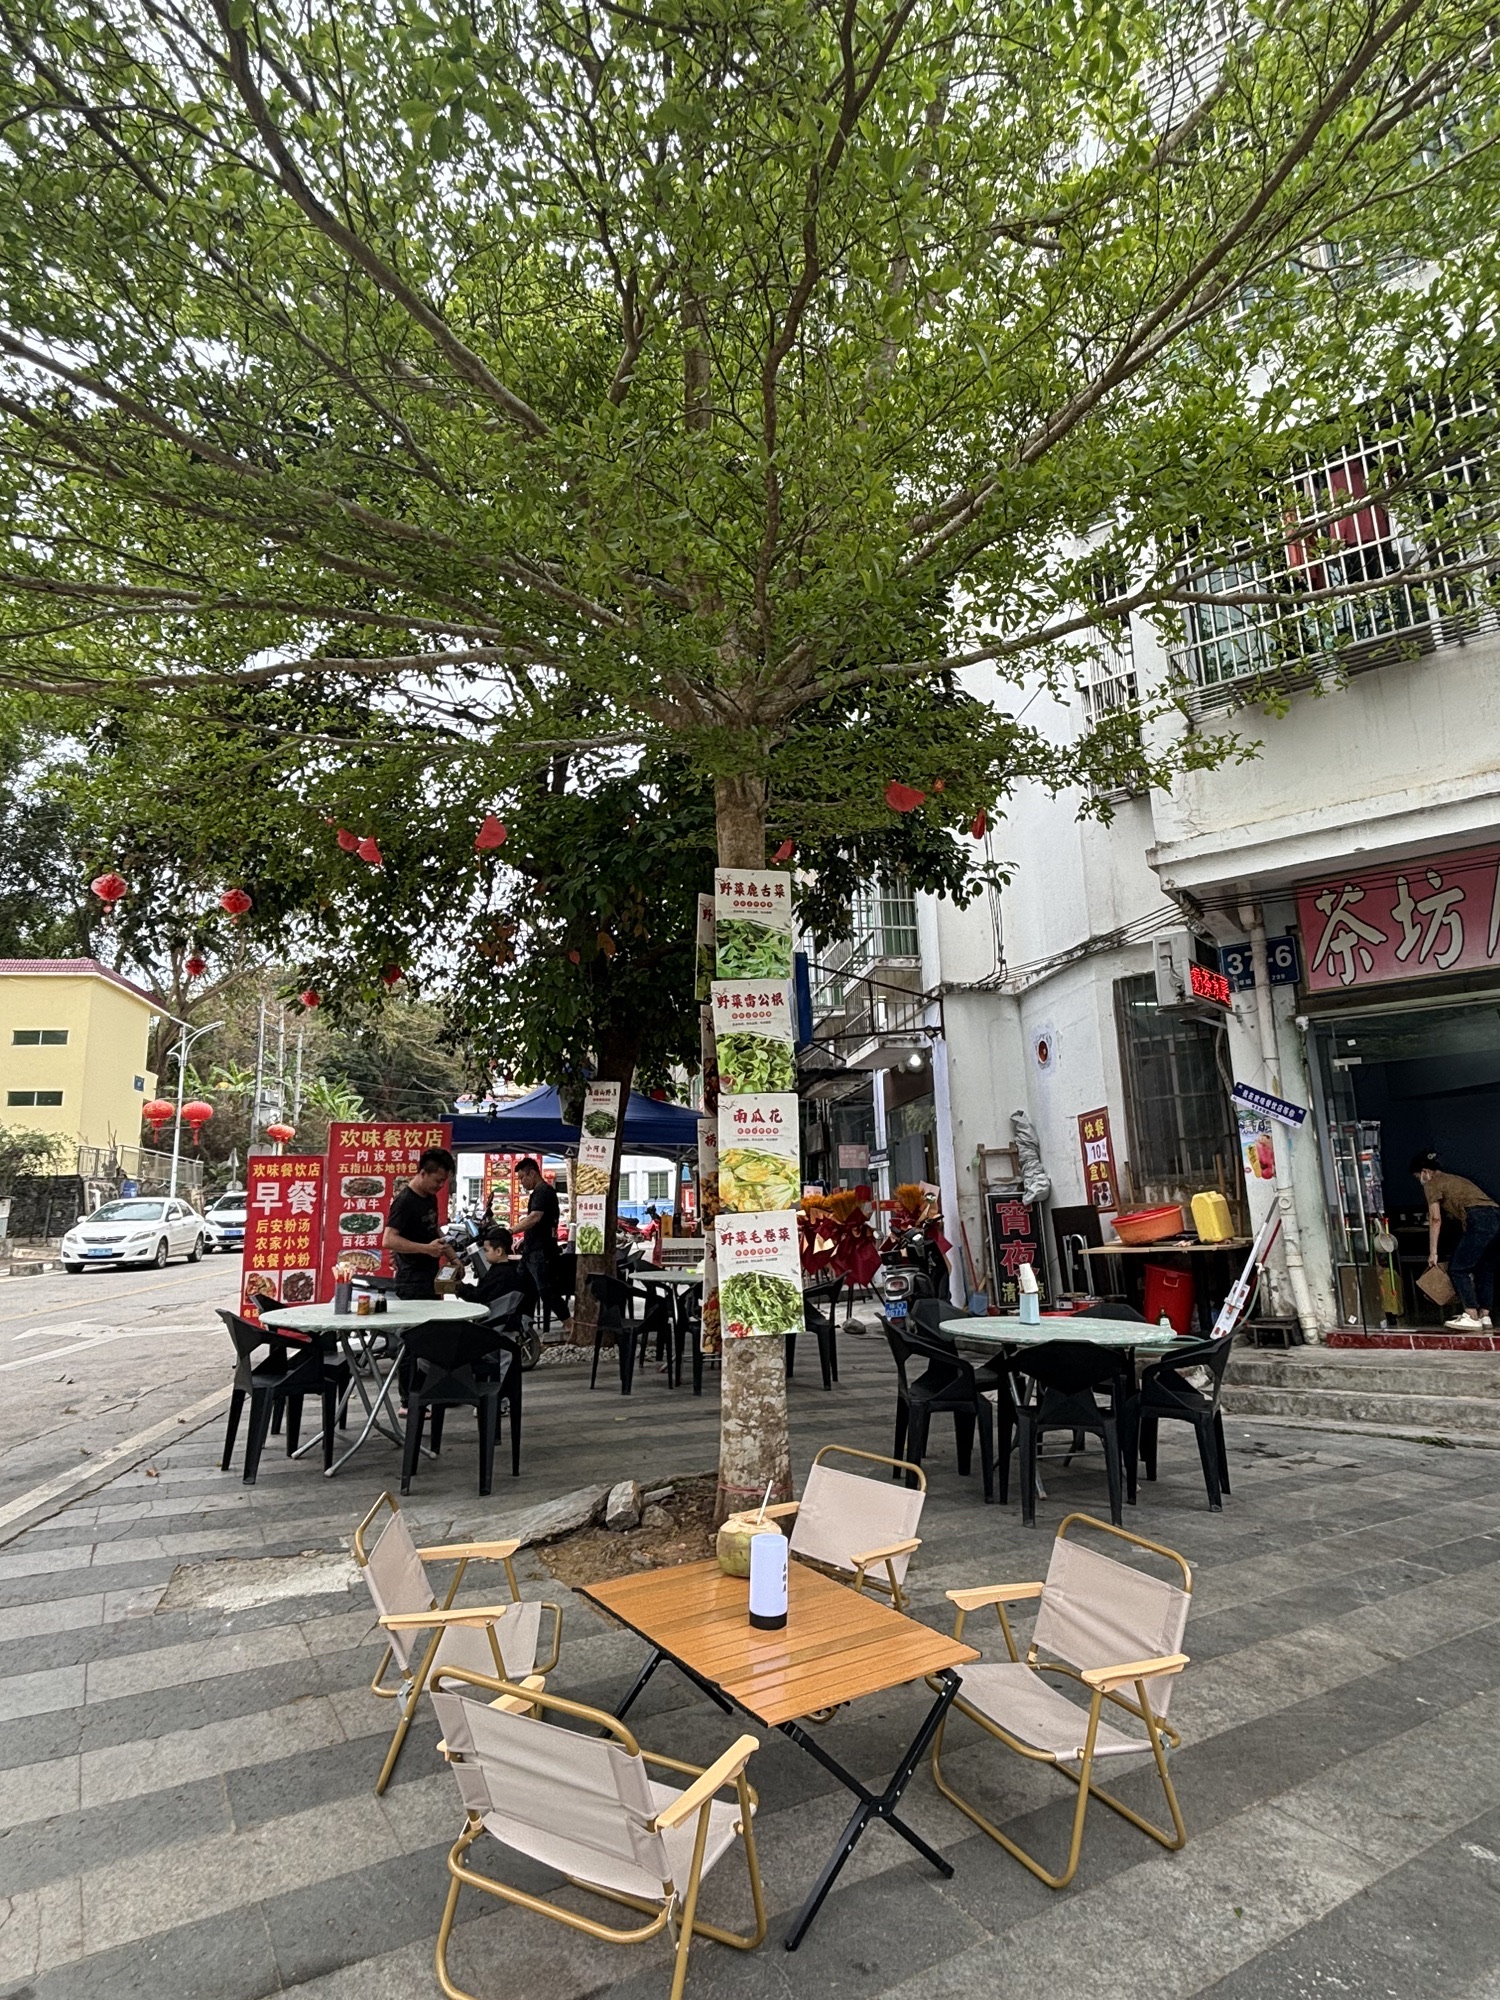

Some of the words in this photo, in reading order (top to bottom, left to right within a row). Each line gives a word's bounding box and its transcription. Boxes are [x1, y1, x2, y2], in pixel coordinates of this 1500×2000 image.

[720, 882, 785, 898] 野菜鹿舌菜
[1312, 862, 1500, 986] 茶坊
[717, 992, 784, 1009] 野菜雷公根
[733, 1108, 783, 1124] 南瓜花
[1084, 1118, 1105, 1140] 快餐
[339, 1128, 444, 1148] 欢味餐饮店
[1091, 1143, 1102, 1160] 10
[252, 1162, 320, 1178] 欢味餐饮店
[338, 1163, 418, 1174] 五指山本地特色
[251, 1180, 317, 1216] 早餐
[343, 1199, 380, 1211] 小黄牛
[256, 1218, 311, 1234] 后安粉汤
[255, 1235, 310, 1251] 农家小炒
[342, 1235, 378, 1247] 百花菜
[720, 1227, 791, 1246] 野菜毛卷菜
[996, 1200, 1040, 1277] 宵夜
[252, 1253, 279, 1268] 快餐
[283, 1252, 311, 1267] 炒粉
